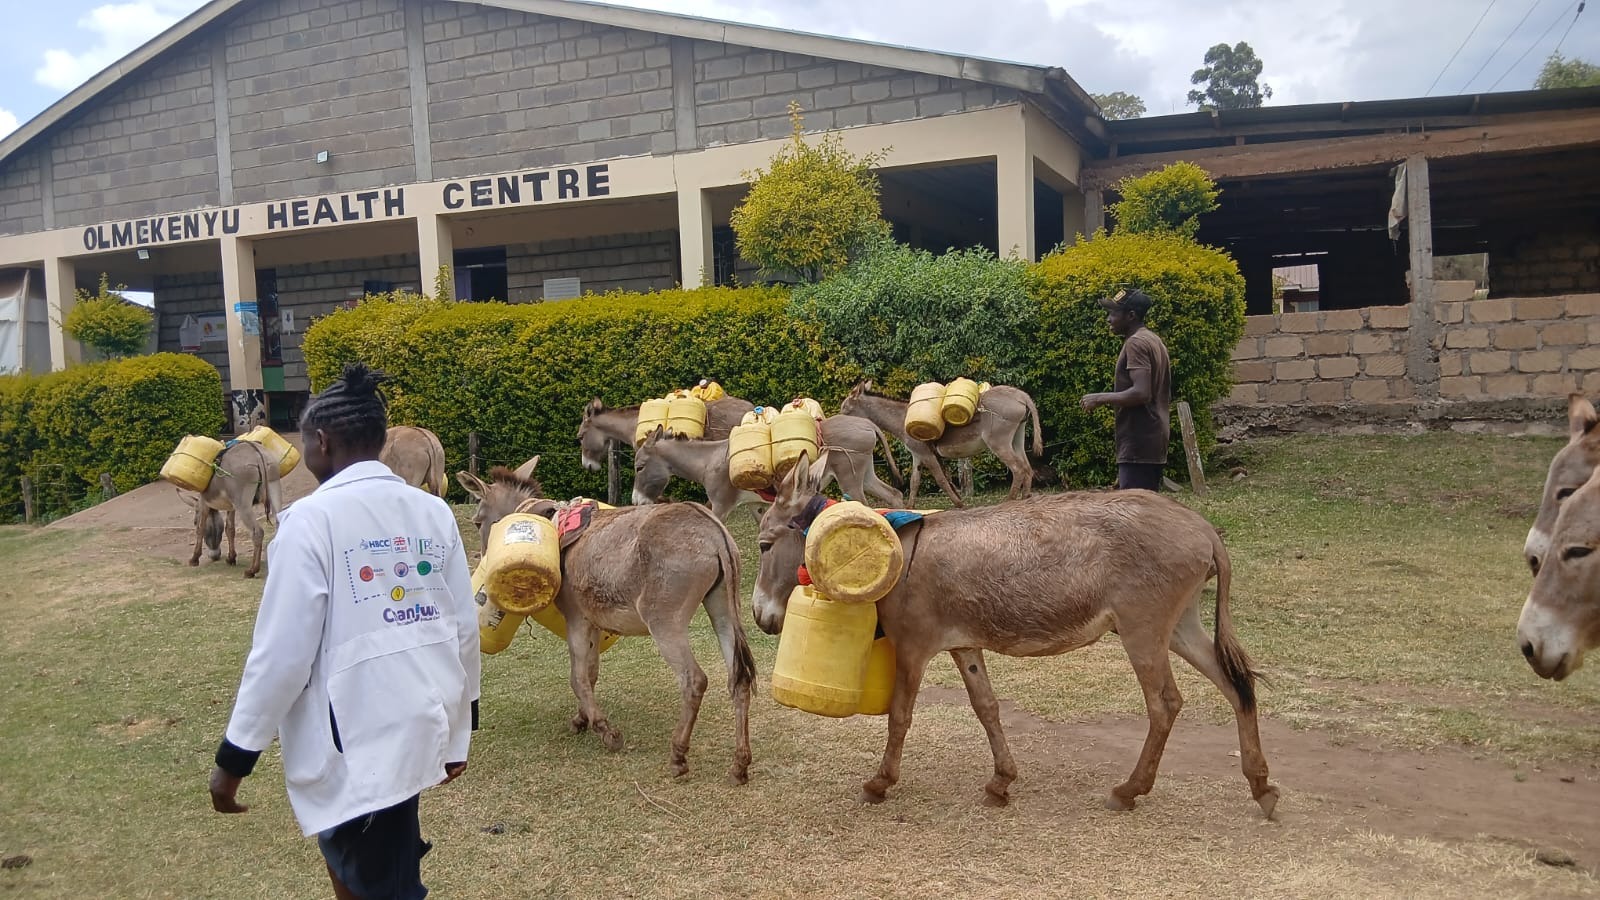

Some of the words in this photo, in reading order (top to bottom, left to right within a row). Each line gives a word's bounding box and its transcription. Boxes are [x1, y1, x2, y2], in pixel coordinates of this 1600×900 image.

[83, 204, 240, 251] OLMEKENYU
[267, 187, 405, 230] HEALTH
[442, 164, 610, 210] CENTRE
